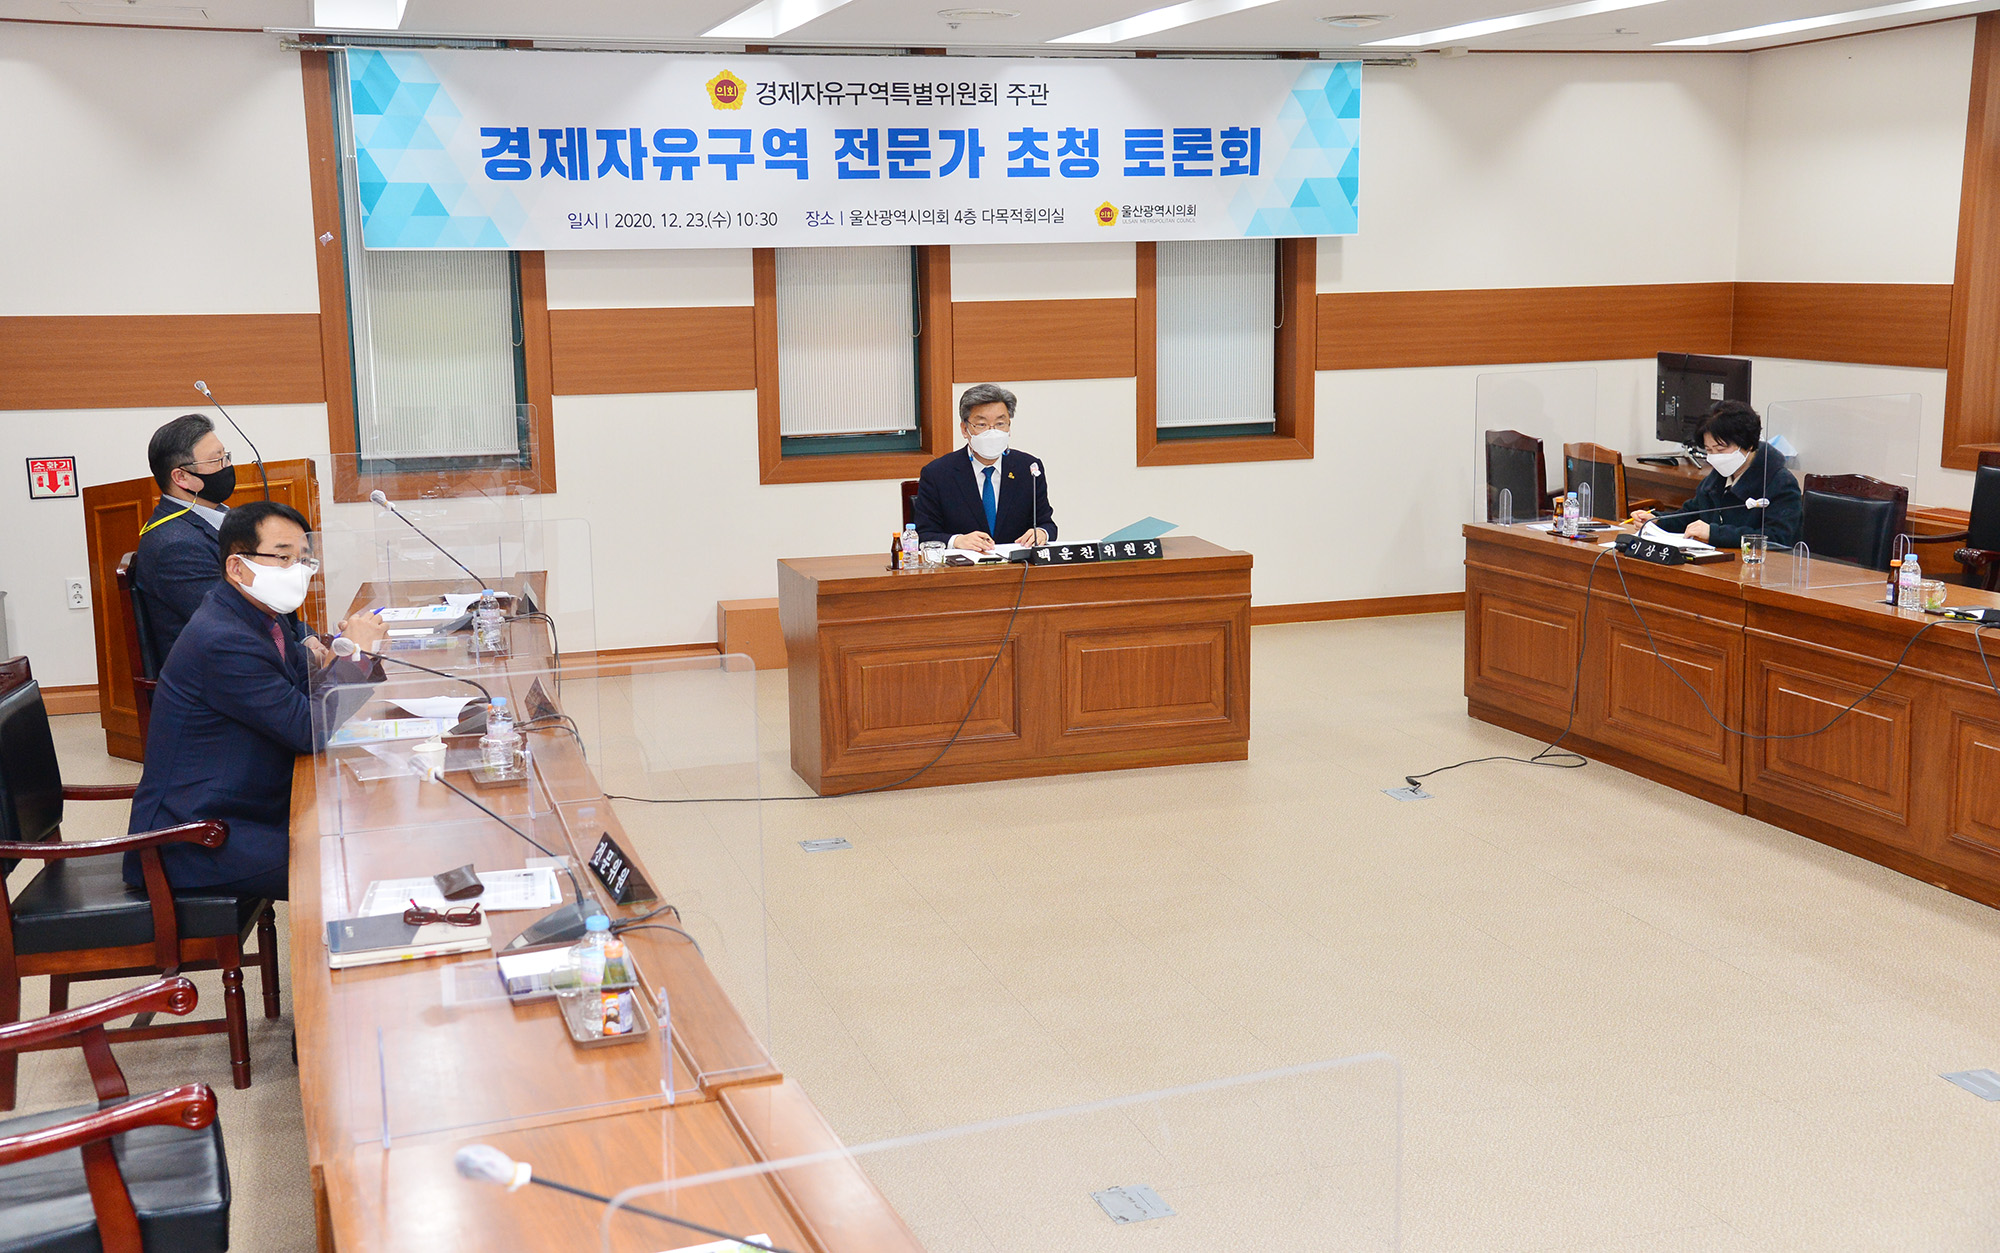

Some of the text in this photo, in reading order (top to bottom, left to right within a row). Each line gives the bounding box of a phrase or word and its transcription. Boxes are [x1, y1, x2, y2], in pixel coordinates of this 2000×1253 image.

[716, 85, 738, 97] 의회
[756, 81, 1050, 108] 경제자유구역특별위원회 주관
[479, 126, 1262, 181] 경제자유구역 전문가 초청 토론회
[567, 212, 599, 230] 일시
[614, 213, 656, 229] 2020.
[661, 213, 682, 229] 12.
[736, 211, 778, 228] 10:30
[805, 207, 1065, 228] 장소 울산광역시의회 4층 다목적회의실
[1121, 204, 1197, 218] 울산광역시의회
[33, 461, 71, 470] 소화기
[1036, 542, 1158, 561] 백운찬 위원장
[1630, 542, 1670, 561] 이상옥
[593, 841, 630, 894] 전문위원
